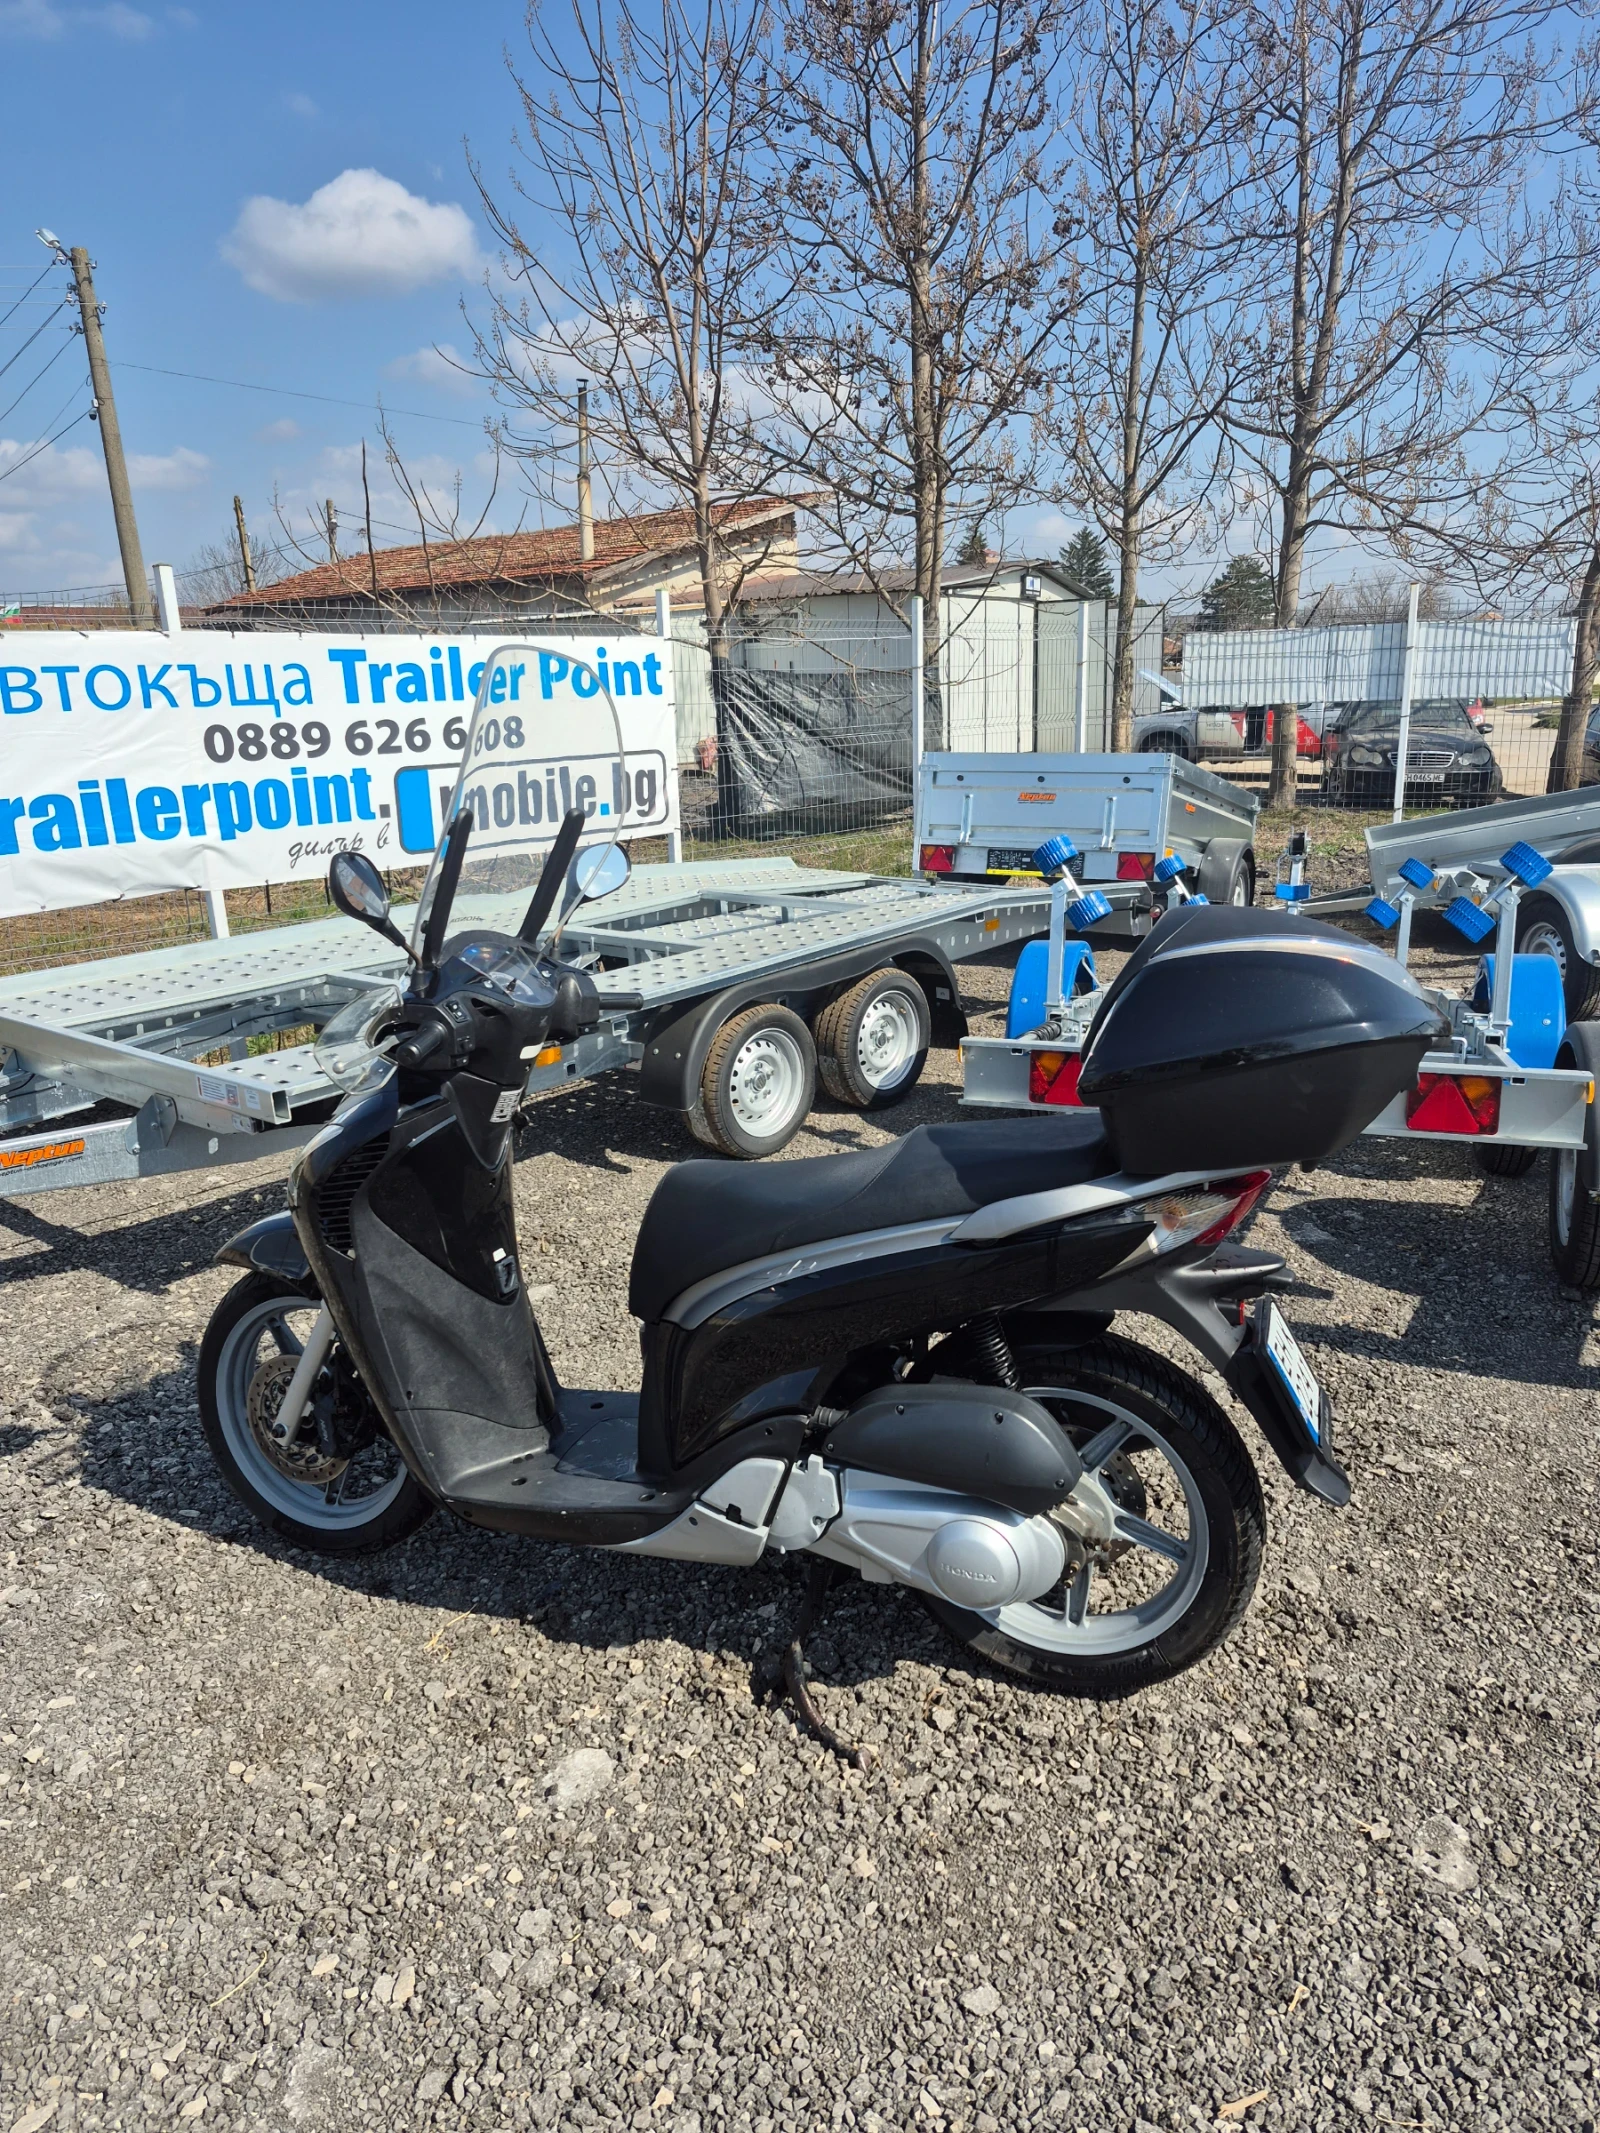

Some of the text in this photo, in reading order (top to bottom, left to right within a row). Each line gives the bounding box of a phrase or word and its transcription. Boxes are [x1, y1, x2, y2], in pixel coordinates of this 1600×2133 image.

[328, 646, 526, 706] Trailer
[538, 647, 663, 700] Point
[203, 720, 331, 763] 0889
[344, 717, 431, 756] 626
[0, 1139, 86, 1167] Neptun
[940, 1561, 998, 1584] HONDA
